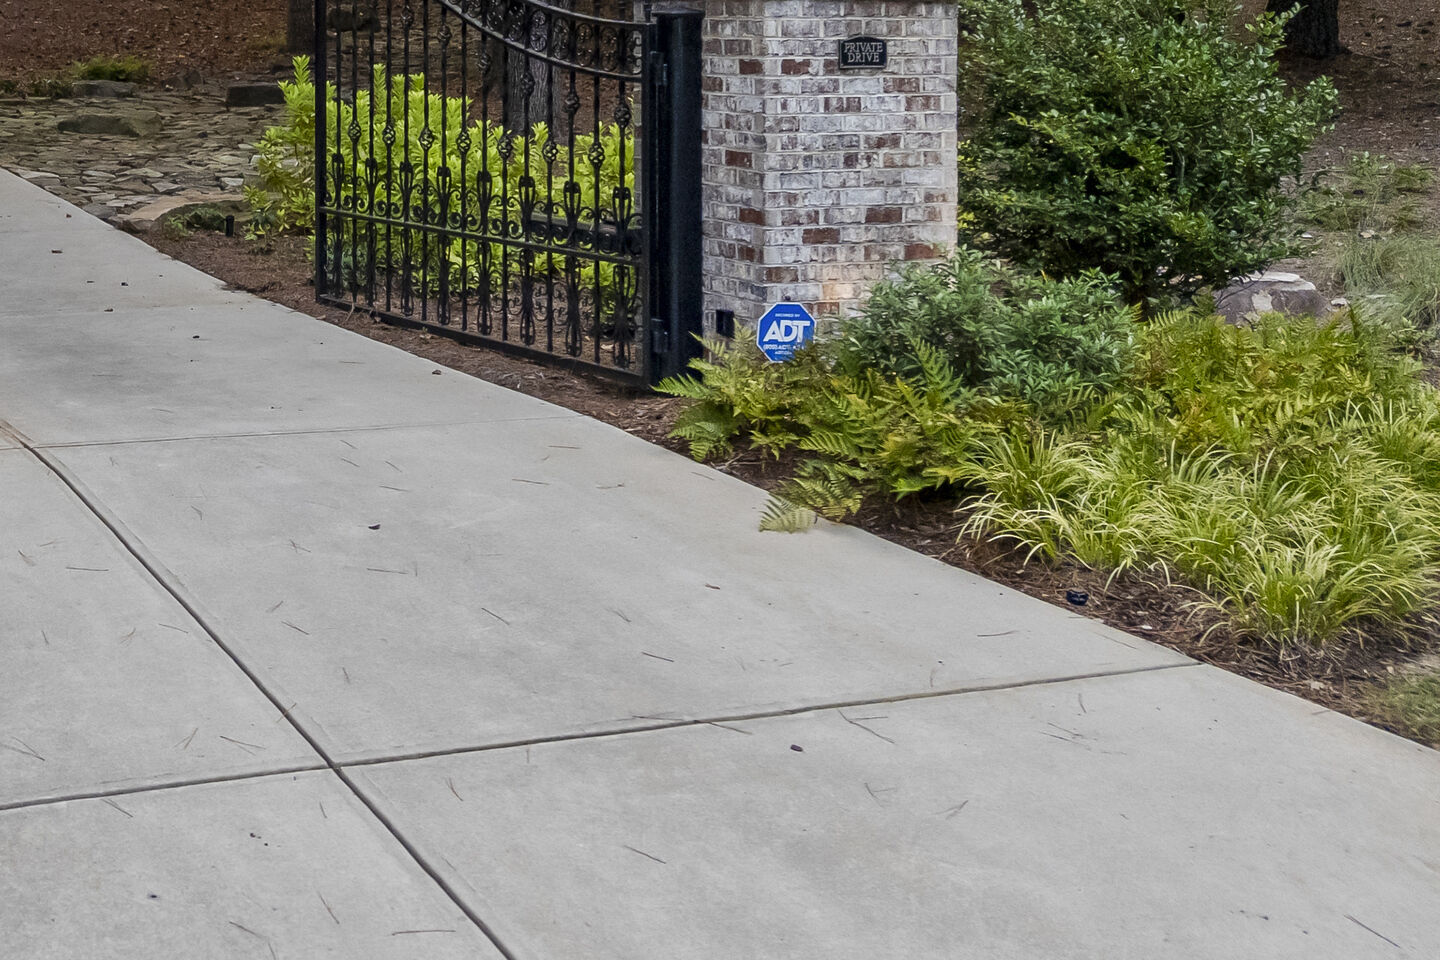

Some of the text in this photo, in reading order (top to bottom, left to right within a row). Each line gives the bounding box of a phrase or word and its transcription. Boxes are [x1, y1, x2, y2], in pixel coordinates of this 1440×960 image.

[843, 42, 883, 53] PRIVATE
[847, 52, 880, 63] DRIVE
[762, 319, 811, 343] ADT
